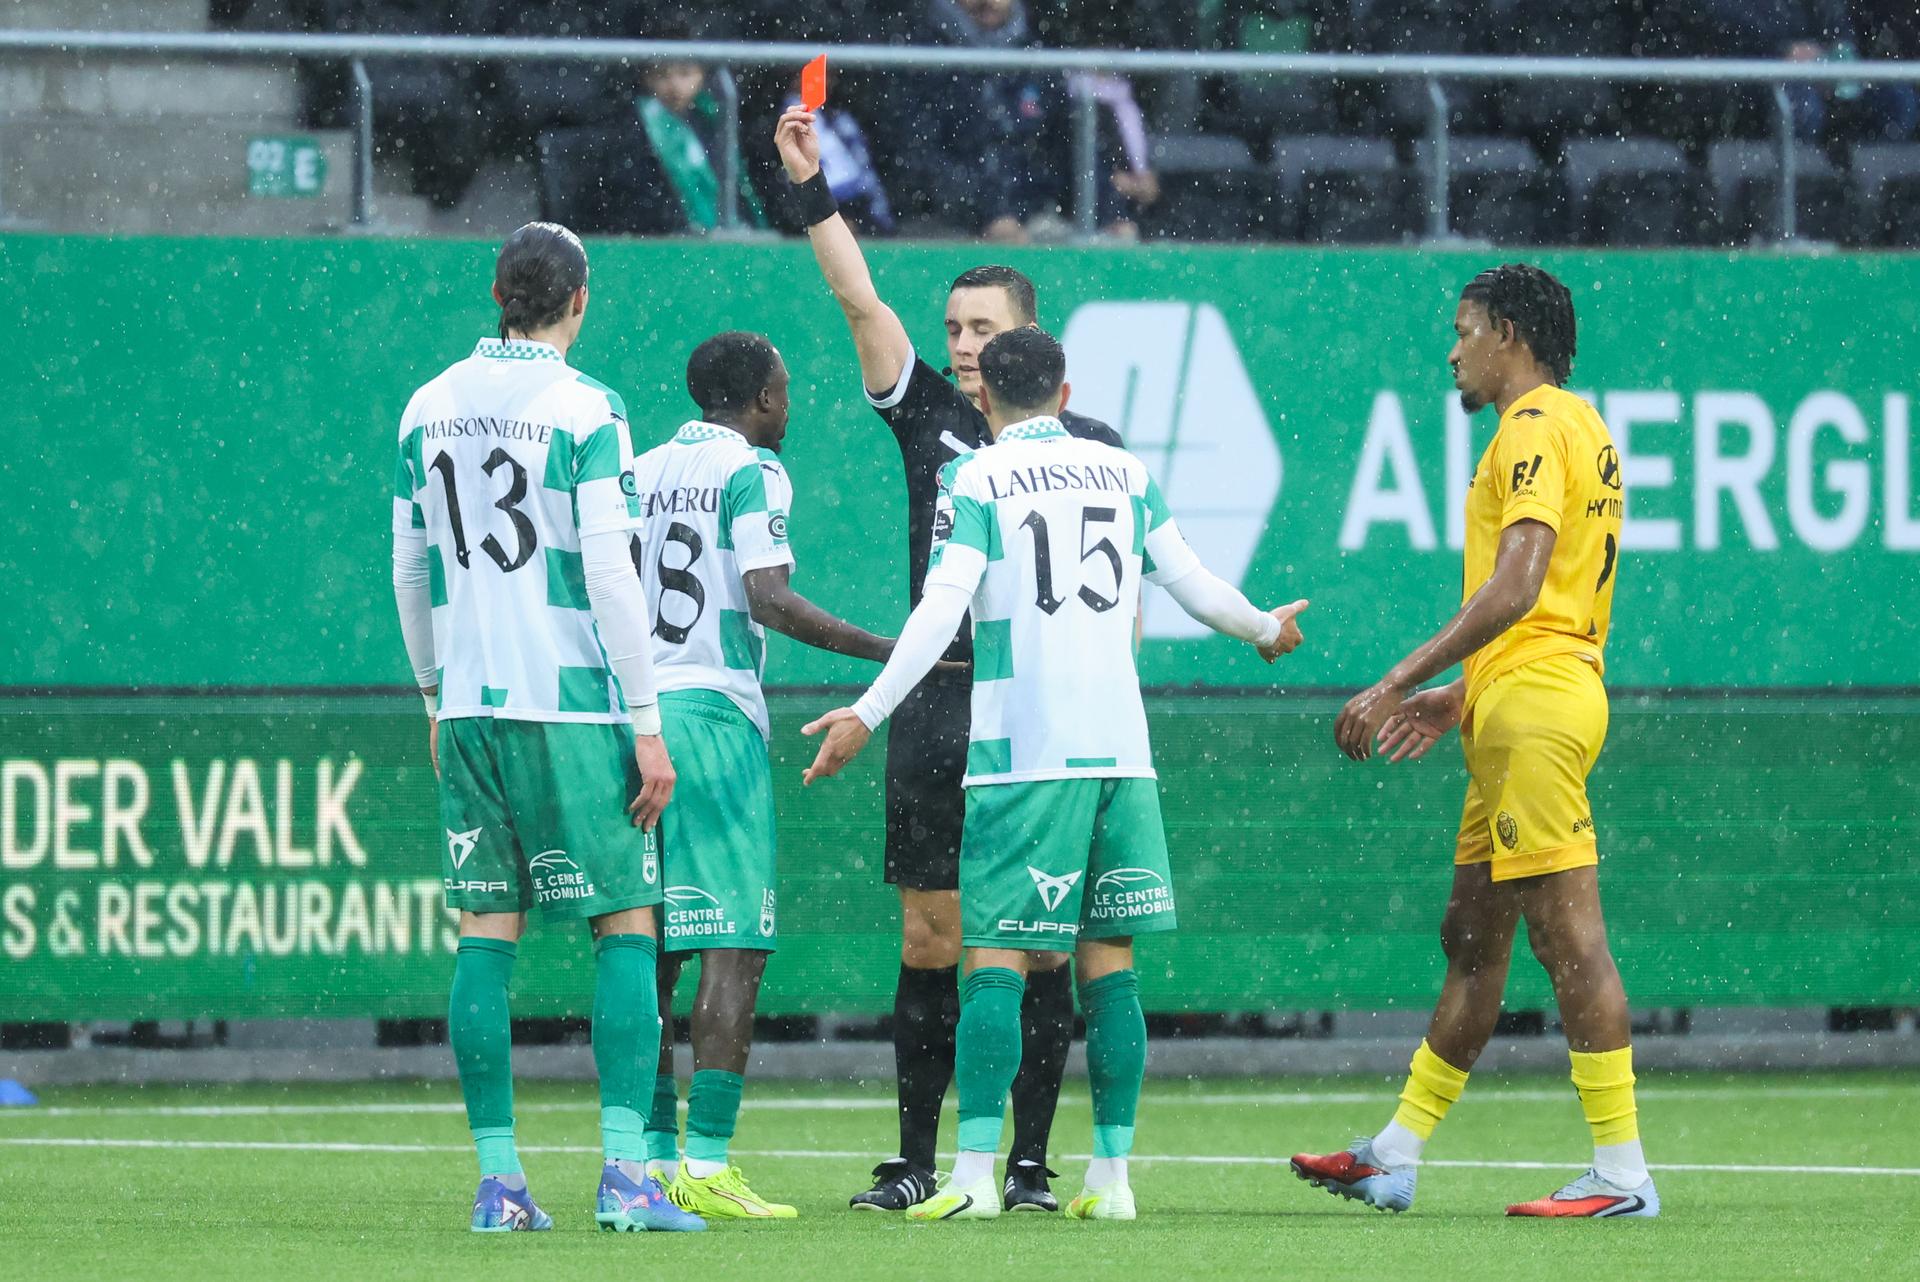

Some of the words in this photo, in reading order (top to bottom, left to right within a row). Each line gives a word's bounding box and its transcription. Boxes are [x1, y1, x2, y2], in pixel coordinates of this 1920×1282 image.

[424, 416, 551, 444] MAISONNEUVE
[987, 464, 1130, 500] LAHSSAINI
[1337, 387, 1920, 552] ALERGL
[428, 446, 537, 573] 13
[637, 487, 719, 518] HMERU
[1018, 506, 1123, 616] 15
[1, 757, 154, 869] DER
[170, 756, 369, 868] VALK
[643, 833, 656, 851] 13
[762, 887, 775, 907] 18
[1090, 897, 1175, 919] AUTOMOBILE
[1094, 893, 1111, 905] LE
[1115, 886, 1169, 905] CENTRE
[48, 890, 86, 956] &
[667, 907, 725, 924] CENTRE
[998, 919, 1080, 936] CUPR
